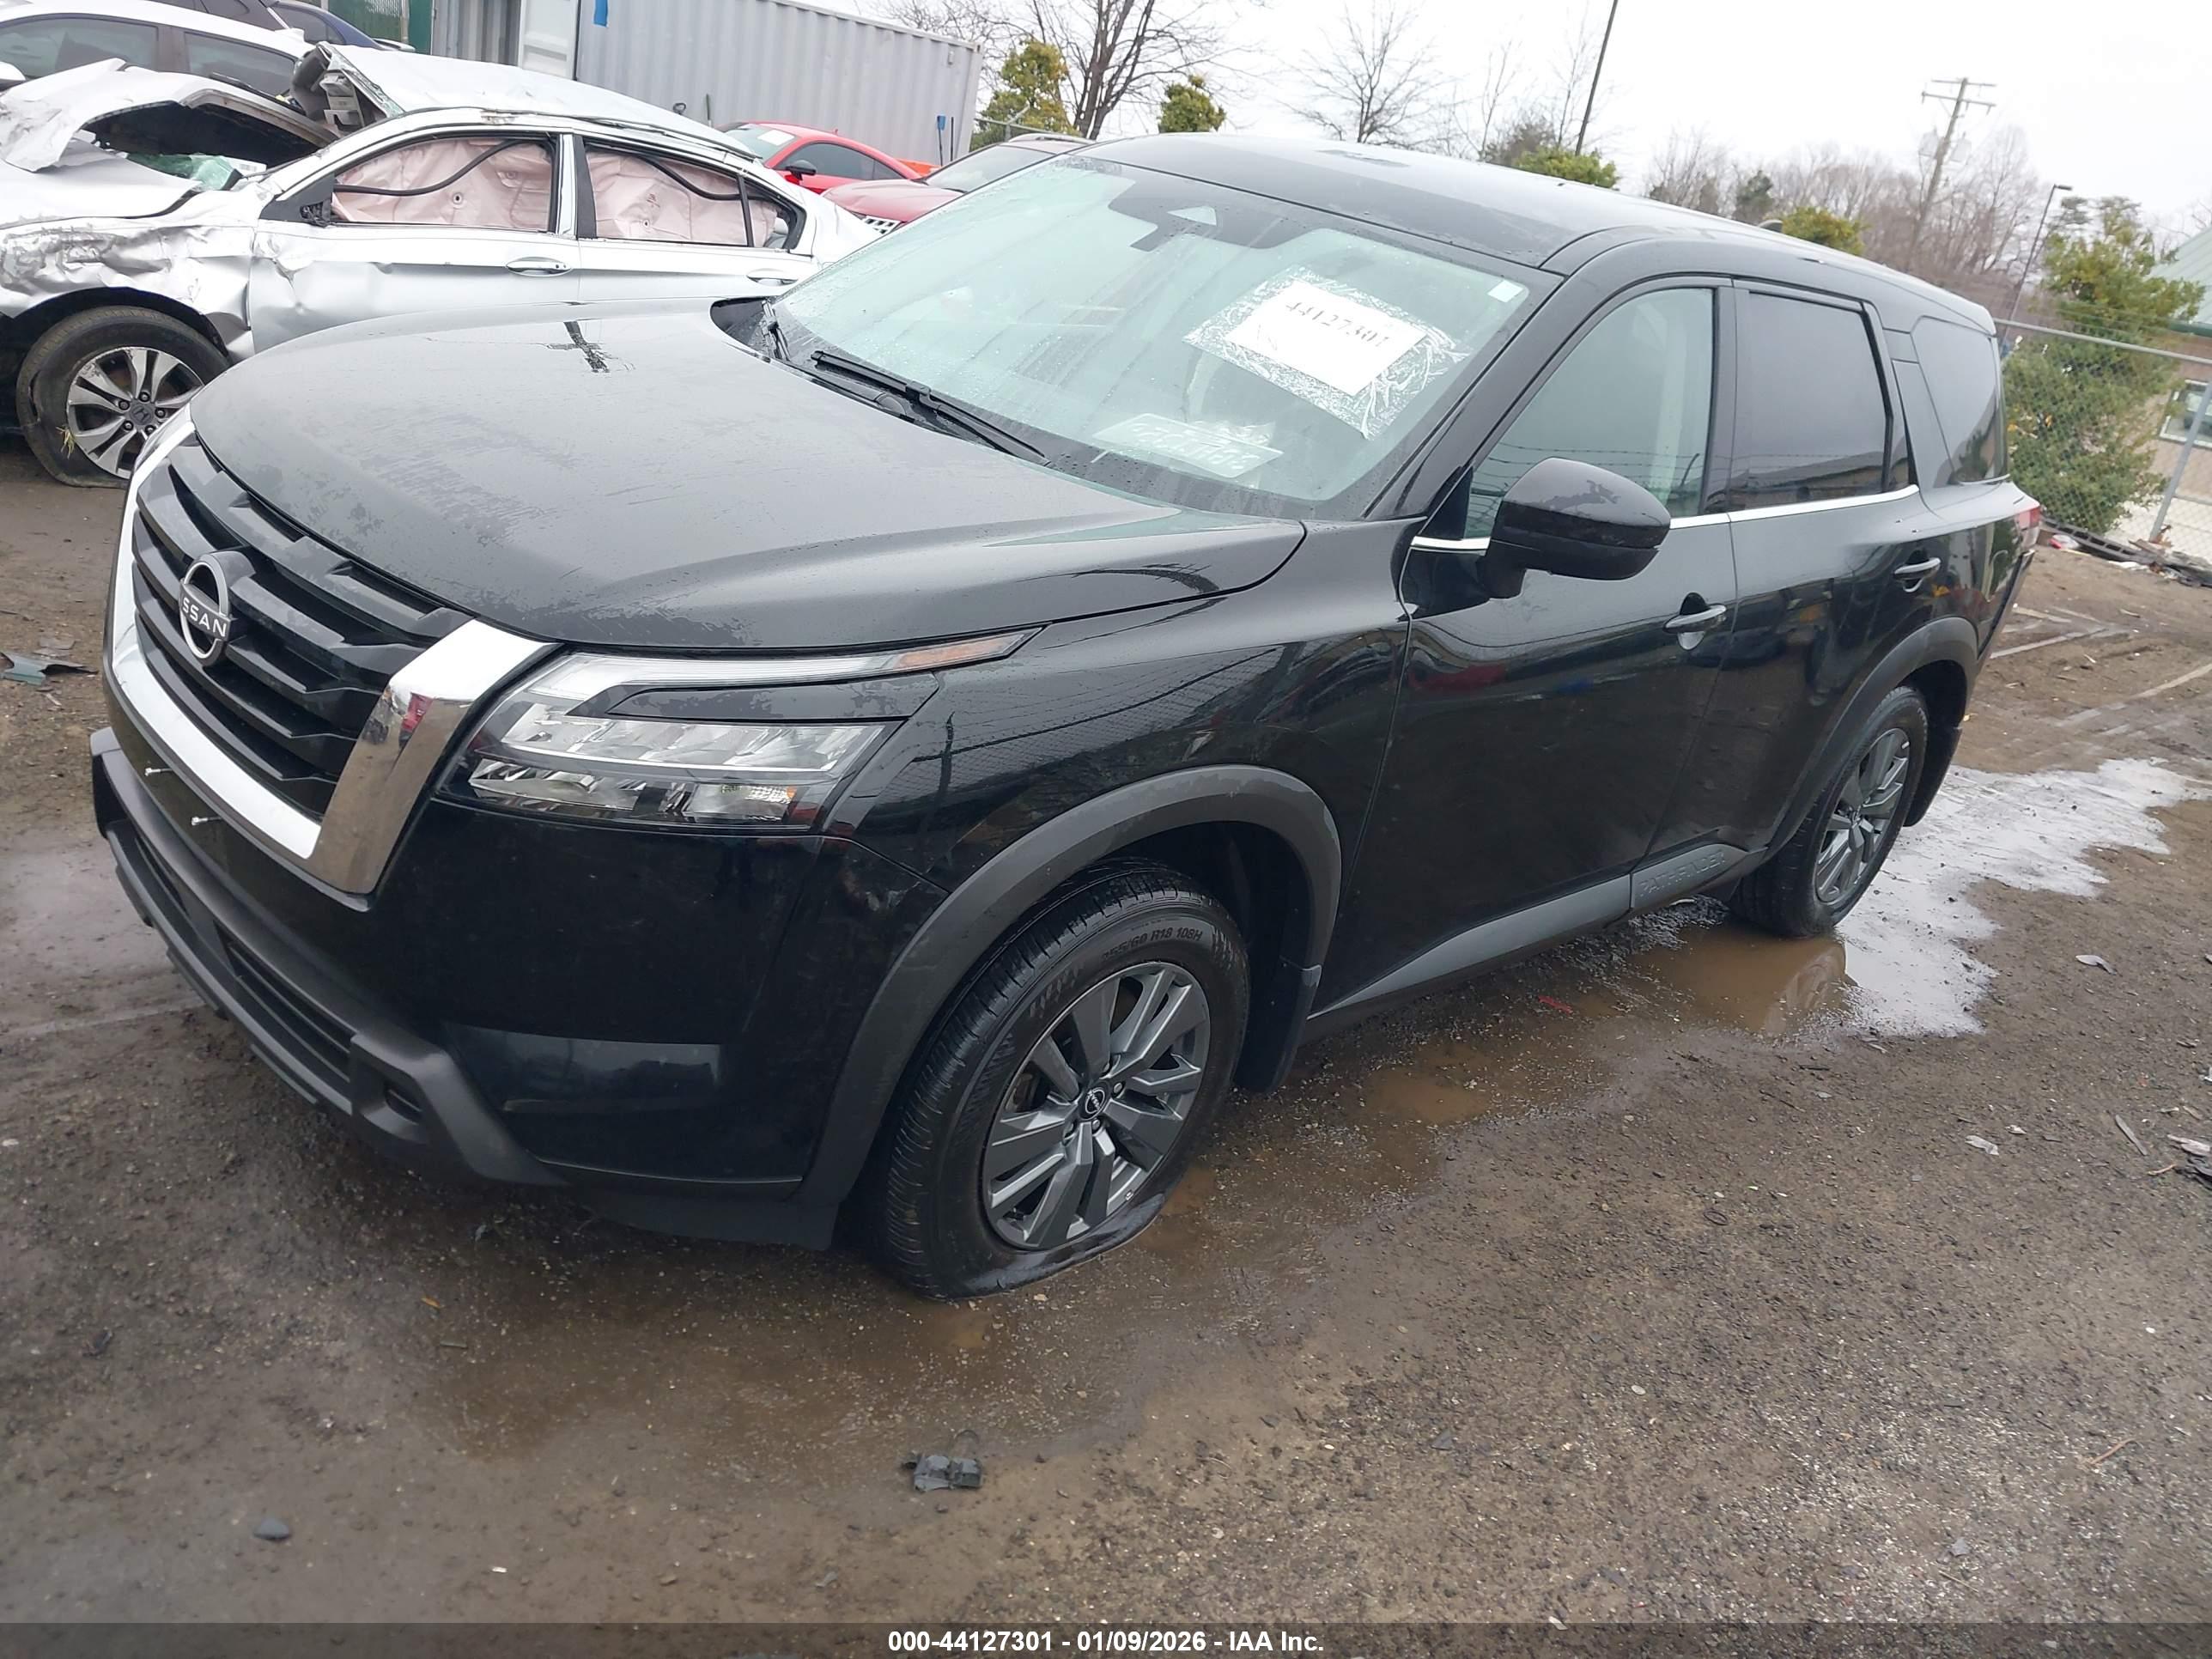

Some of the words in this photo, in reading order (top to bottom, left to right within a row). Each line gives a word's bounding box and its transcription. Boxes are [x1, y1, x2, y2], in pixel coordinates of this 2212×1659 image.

[181, 596, 228, 638] SSAN
[1150, 927, 1173, 942] R18
[1175, 926, 1204, 942] 108H
